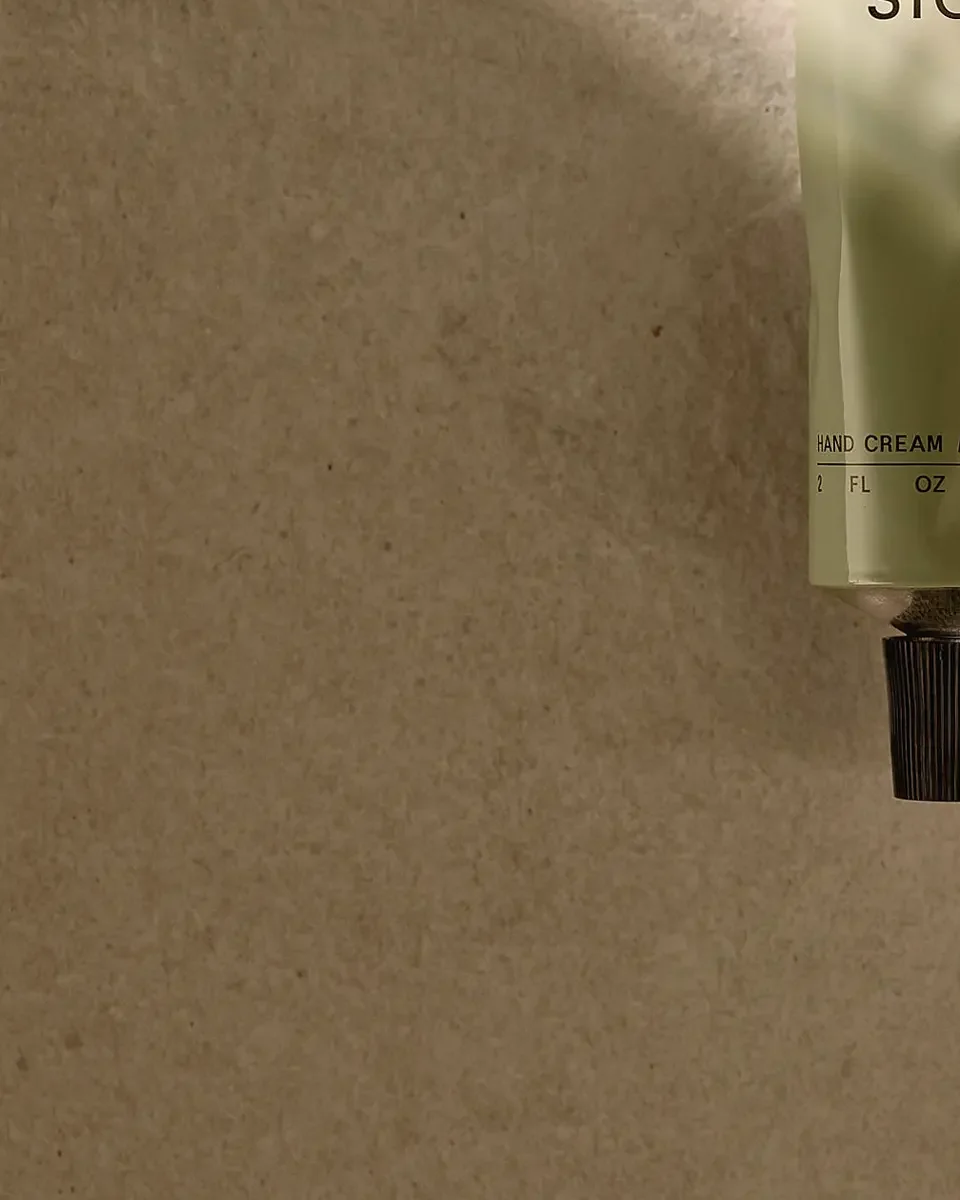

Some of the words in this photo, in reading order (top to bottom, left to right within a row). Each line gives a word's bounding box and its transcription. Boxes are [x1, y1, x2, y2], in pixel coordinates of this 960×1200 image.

[817, 434, 855, 453] HAND
[864, 434, 943, 453] CREAM
[817, 474, 823, 493] 2
[850, 475, 871, 493] FL
[915, 474, 946, 493] OZ
